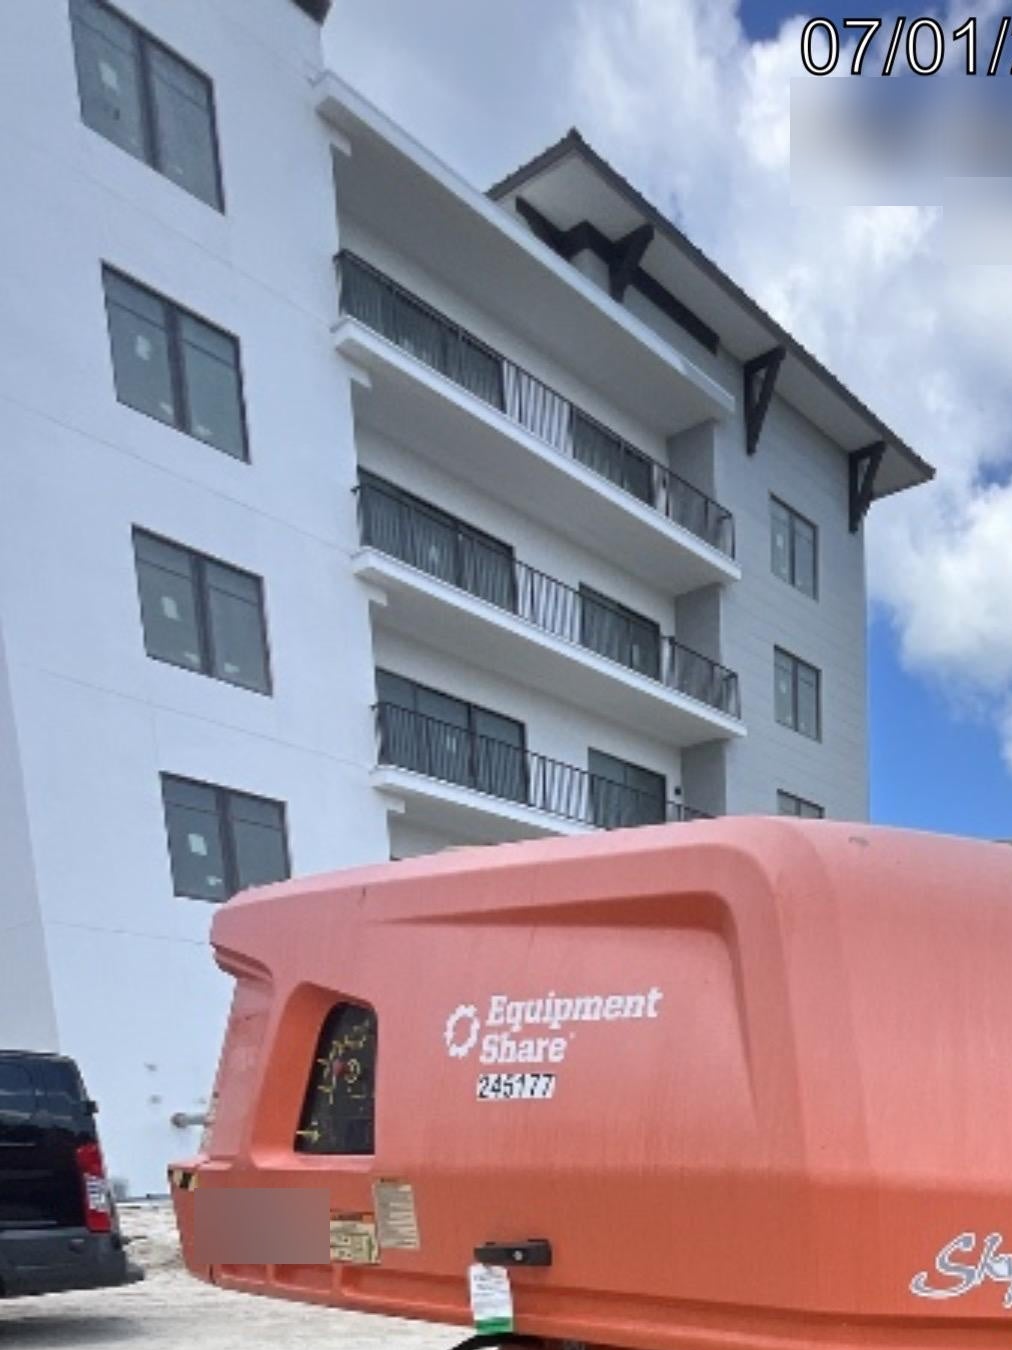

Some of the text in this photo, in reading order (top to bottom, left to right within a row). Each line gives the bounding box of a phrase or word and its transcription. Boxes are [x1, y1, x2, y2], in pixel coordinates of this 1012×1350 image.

[486, 986, 664, 1032] Equipment
[479, 1032, 567, 1064] Share
[477, 1073, 555, 1099] 245177
